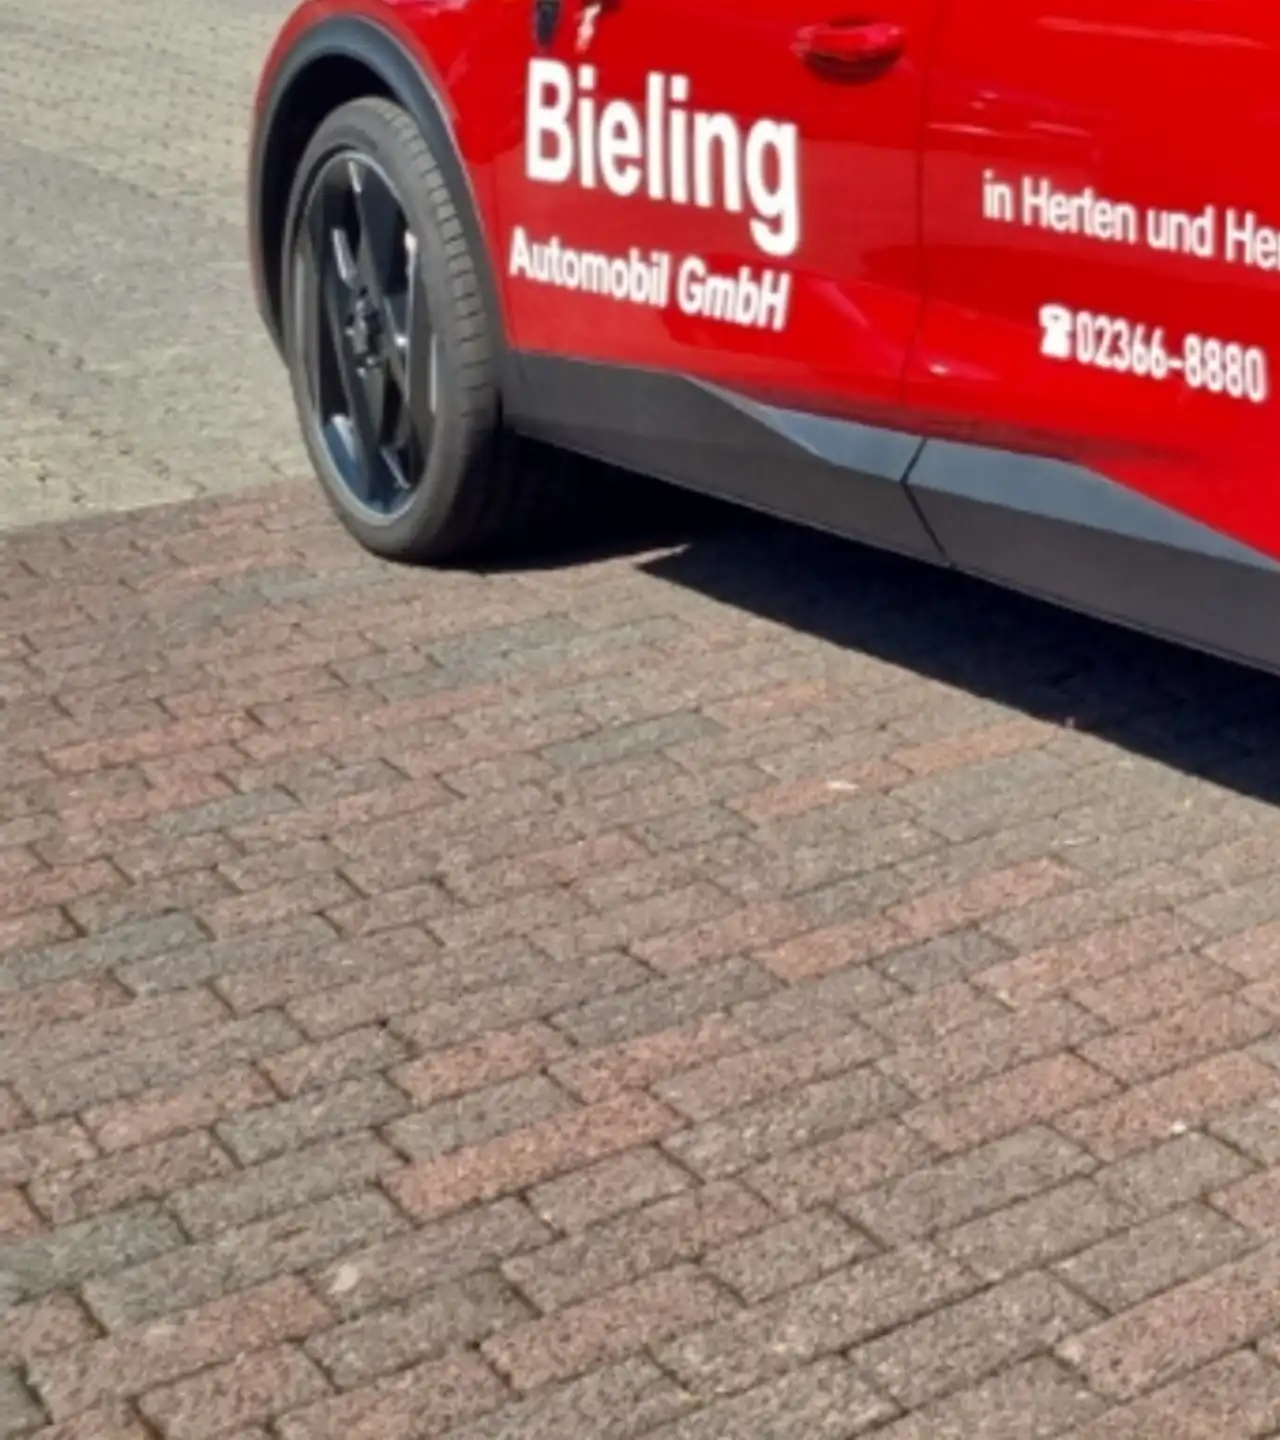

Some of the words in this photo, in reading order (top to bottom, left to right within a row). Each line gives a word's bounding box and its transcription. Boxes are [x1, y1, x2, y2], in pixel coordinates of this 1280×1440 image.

[525, 56, 799, 256] Bieling
[982, 168, 1012, 222] in
[1022, 175, 1137, 245] Herten
[1146, 204, 1214, 257] und
[509, 225, 669, 308] Automobil
[677, 256, 792, 331] GmbH
[1075, 310, 1268, 403] 02366-8880
